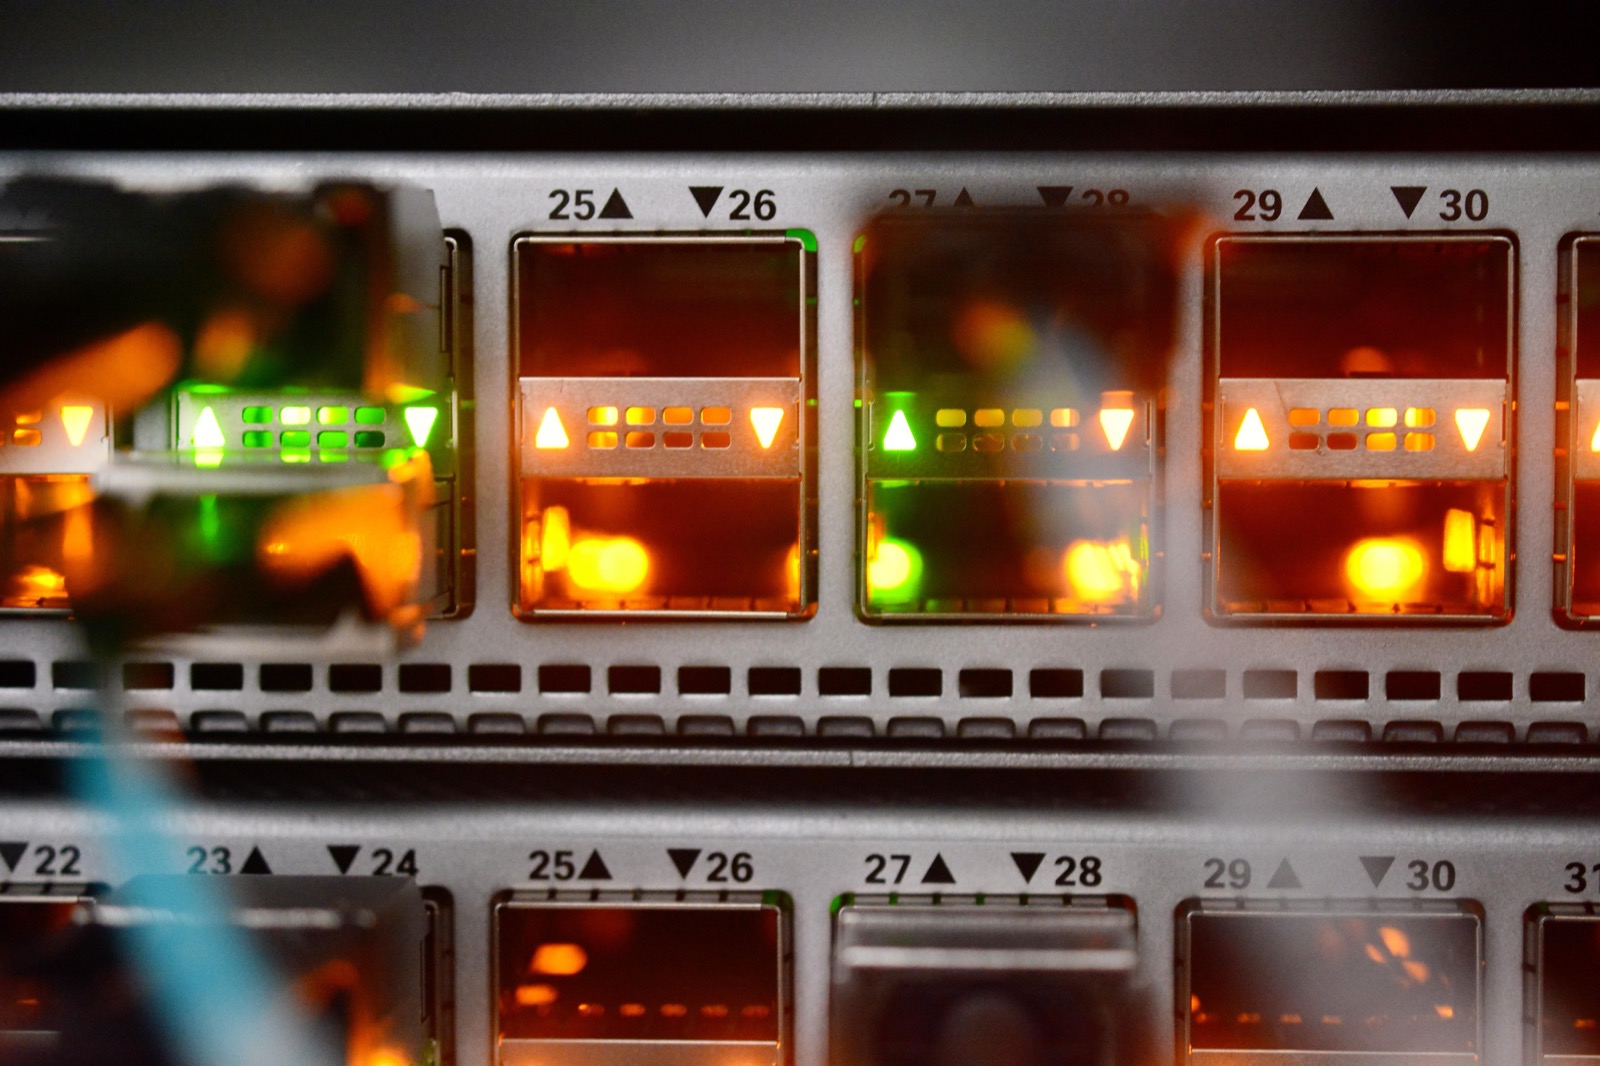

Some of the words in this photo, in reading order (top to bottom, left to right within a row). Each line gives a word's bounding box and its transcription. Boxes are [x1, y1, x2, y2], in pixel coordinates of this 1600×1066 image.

[547, 189, 596, 220] 25
[729, 189, 777, 221] 26
[1233, 189, 1283, 221] 29
[1439, 189, 1489, 221] 30
[35, 845, 81, 875] 22
[187, 845, 232, 874] 23
[372, 848, 418, 875] 24
[529, 850, 575, 880] 25
[706, 852, 754, 883] 26
[865, 854, 911, 884] 27
[1055, 856, 1102, 887] 28
[1203, 858, 1251, 889] 29
[1406, 859, 1456, 891] 30
